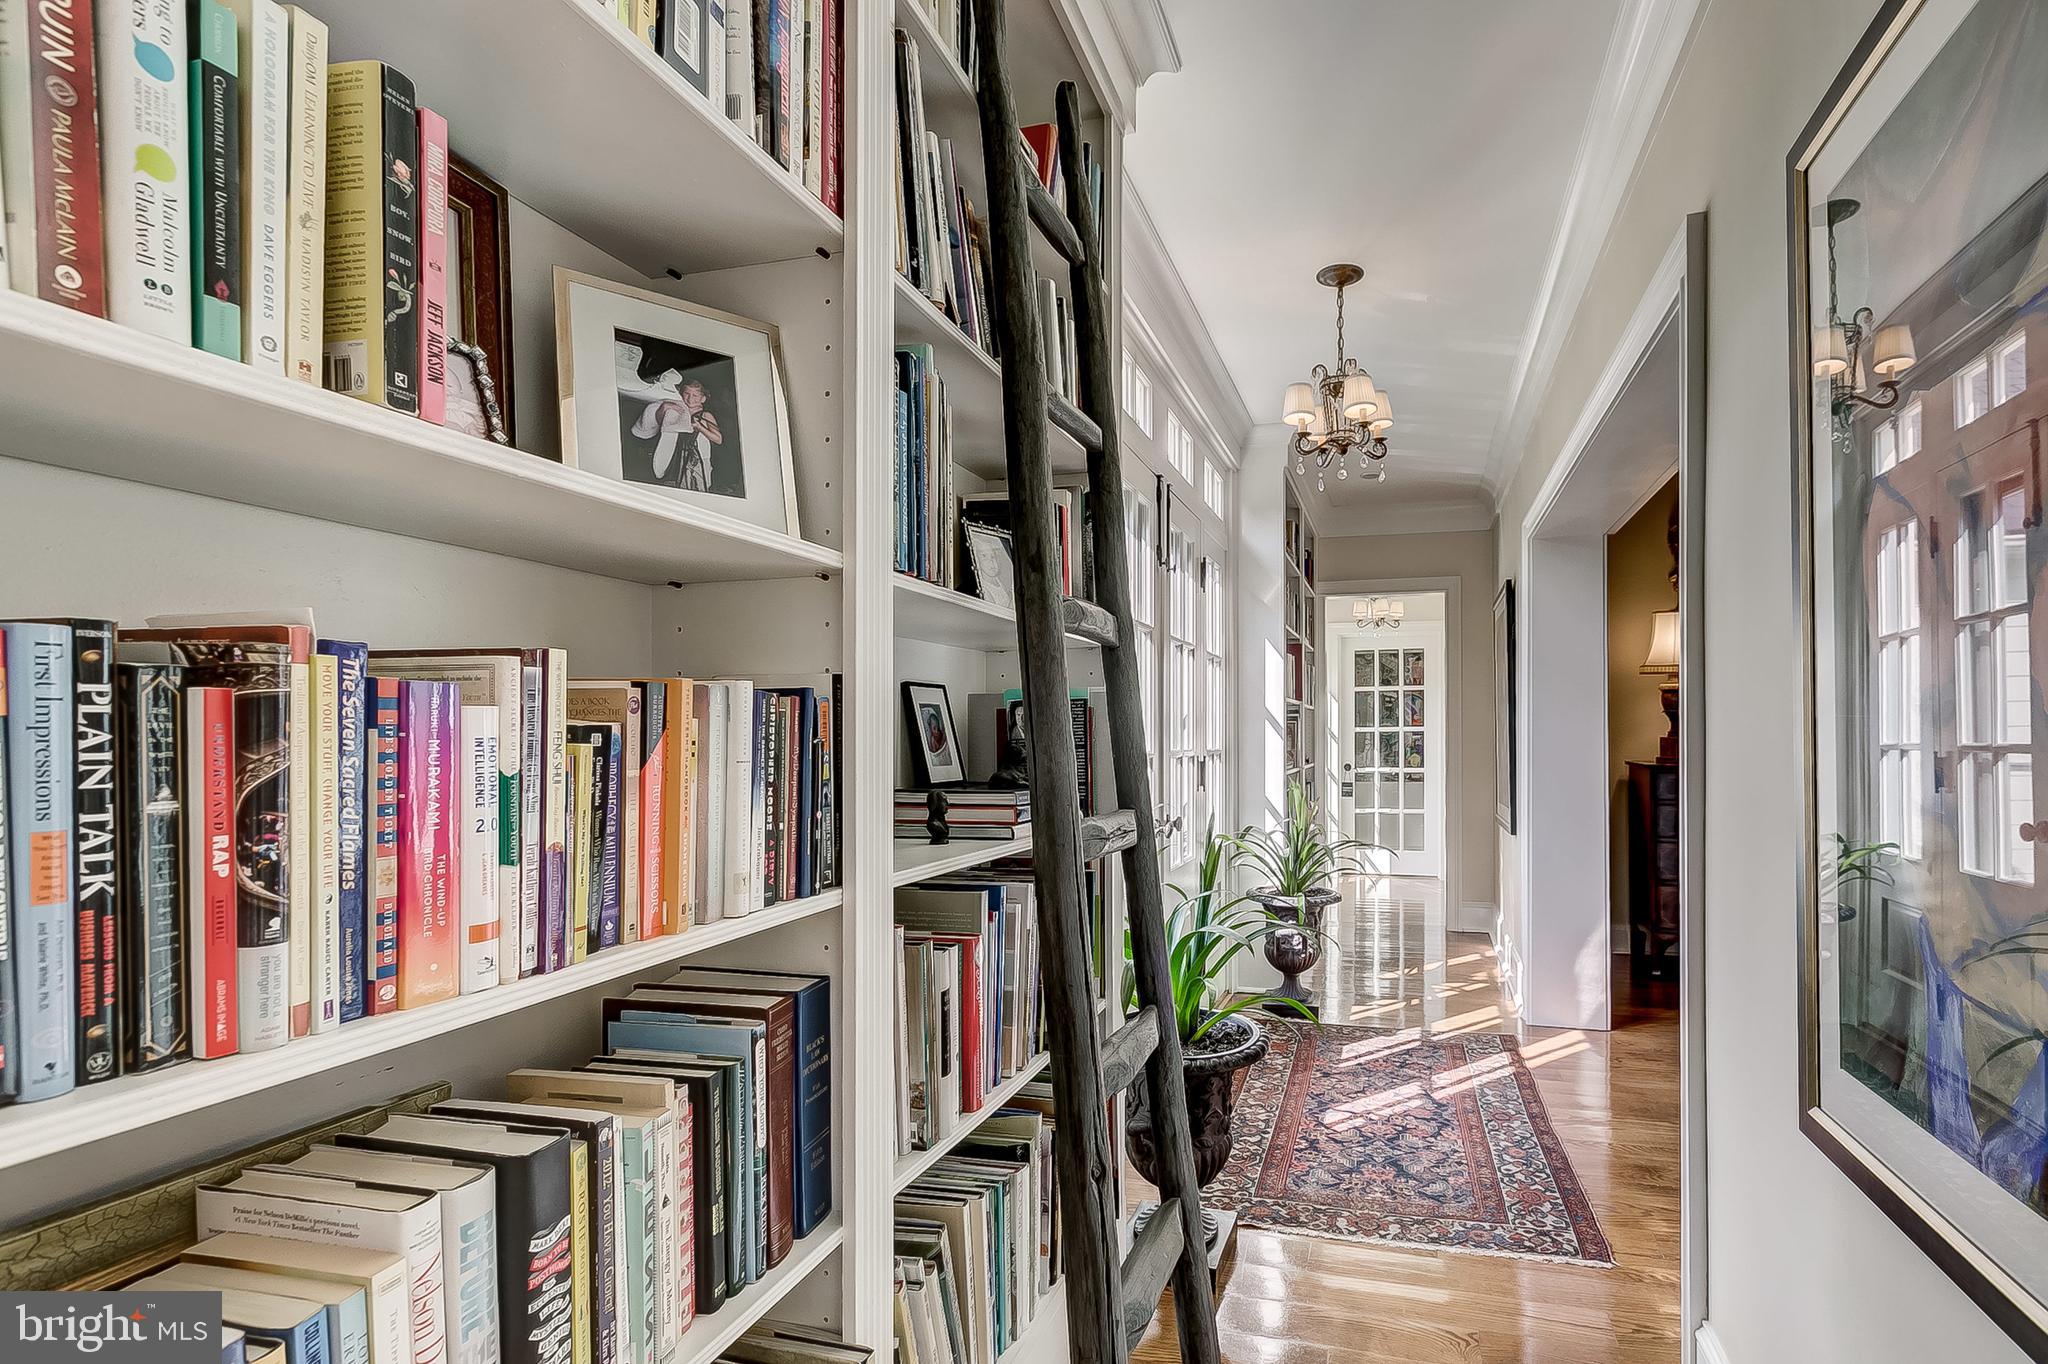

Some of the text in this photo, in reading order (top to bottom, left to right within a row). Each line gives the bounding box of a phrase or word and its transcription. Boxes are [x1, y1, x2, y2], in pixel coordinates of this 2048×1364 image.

[159, 25, 173, 46] to
[212, 74, 228, 269] COMFORTABLE WITH UNCERTAINTY
[262, 11, 277, 321] A HOLOGRAM FOR THE KING DAVE EGGERS
[303, 89, 318, 208] LEARNING TO LIVE
[51, 108, 78, 260] PAULA McLAIN
[426, 141, 444, 237] MIRA CORPORA
[134, 181, 155, 268] Gladwell
[162, 191, 180, 273] Malcolm
[389, 203, 411, 220] BOY,
[387, 227, 415, 246] SNOW,
[389, 251, 412, 268] BIRD
[300, 234, 313, 342] MADISYN TAYLOR
[425, 298, 445, 385] JEFF JACKSON
[34, 640, 63, 688] First
[322, 664, 333, 698] MOVE
[296, 676, 307, 724] Traditional
[322, 702, 333, 733] YOUR
[588, 697, 610, 705] BOOK
[26, 695, 63, 822] Impressions
[427, 695, 441, 831] HARUKI MURAKAMI
[474, 736, 485, 809] INTELLIGENCE
[487, 736, 497, 808] EMOTIONAL
[510, 741, 517, 756] OF
[553, 730, 562, 785] FENG SHUI
[766, 696, 777, 831] CHRISTOPHER MOORE
[77, 680, 116, 901] PLAIN TALK
[341, 658, 360, 891] The Seven Sacred Flames
[594, 756, 603, 806] Clarissa Pinkola
[791, 745, 799, 801] My Deepest
[212, 723, 231, 878] UNDERSTAND RAP
[322, 778, 333, 826] CHANGE
[510, 779, 518, 862] FOUNTAIN YOUTH
[322, 829, 333, 860] YOUR
[383, 718, 394, 964] LIFE'S GOLDEN TICKET BURCHARD
[475, 818, 498, 834] 2.0
[650, 784, 660, 915] RUNNING SCISSORS
[323, 864, 333, 889] LIFE
[592, 809, 603, 904] Women Who Run With the
[603, 836, 616, 907] MILLENNIUM
[423, 848, 434, 938] BIRD CHRONICLE
[436, 854, 446, 927] THE WIND-UP
[324, 909, 332, 935] KAREN
[524, 902, 536, 930] Collins
[80, 909, 96, 1017] BUSINESS MAVERICK
[102, 914, 115, 996] LESSONS FROM
[344, 928, 354, 955] Aurelia
[215, 979, 227, 1012] ABRAMS
[256, 955, 271, 995] stranger
[324, 963, 332, 996] CARTER
[258, 997, 271, 1019] here
[802, 1053, 829, 1078] DICTIONARY
[806, 1034, 825, 1054] BLACK'S
[811, 1049, 821, 1060] LAW
[602, 1156, 613, 1190] 2012:
[232, 1206, 252, 1215] Praise
[253, 1207, 262, 1216] for
[263, 1209, 285, 1219] Nelson
[285, 1212, 313, 1224] DeMille's
[313, 1217, 340, 1228] previous
[242, 1217, 257, 1225] New
[257, 1218, 272, 1228] York
[272, 1220, 291, 1230] Times
[291, 1223, 322, 1234] Bestseller
[321, 1227, 334, 1236] The
[334, 1229, 360, 1240] Panther
[577, 1189, 586, 1241] ROSIE
[602, 1193, 614, 1221] YOU
[531, 1236, 552, 1251] MARK
[533, 1252, 553, 1270] BORN
[603, 1221, 614, 1256] HAVE
[604, 1256, 613, 1265] A
[662, 1235, 674, 1274] Energy
[410, 1251, 442, 1344] Nelson
[541, 1298, 563, 1318] LIFE
[603, 1265, 615, 1315] CHOICE!
[662, 1289, 674, 1325] Money
